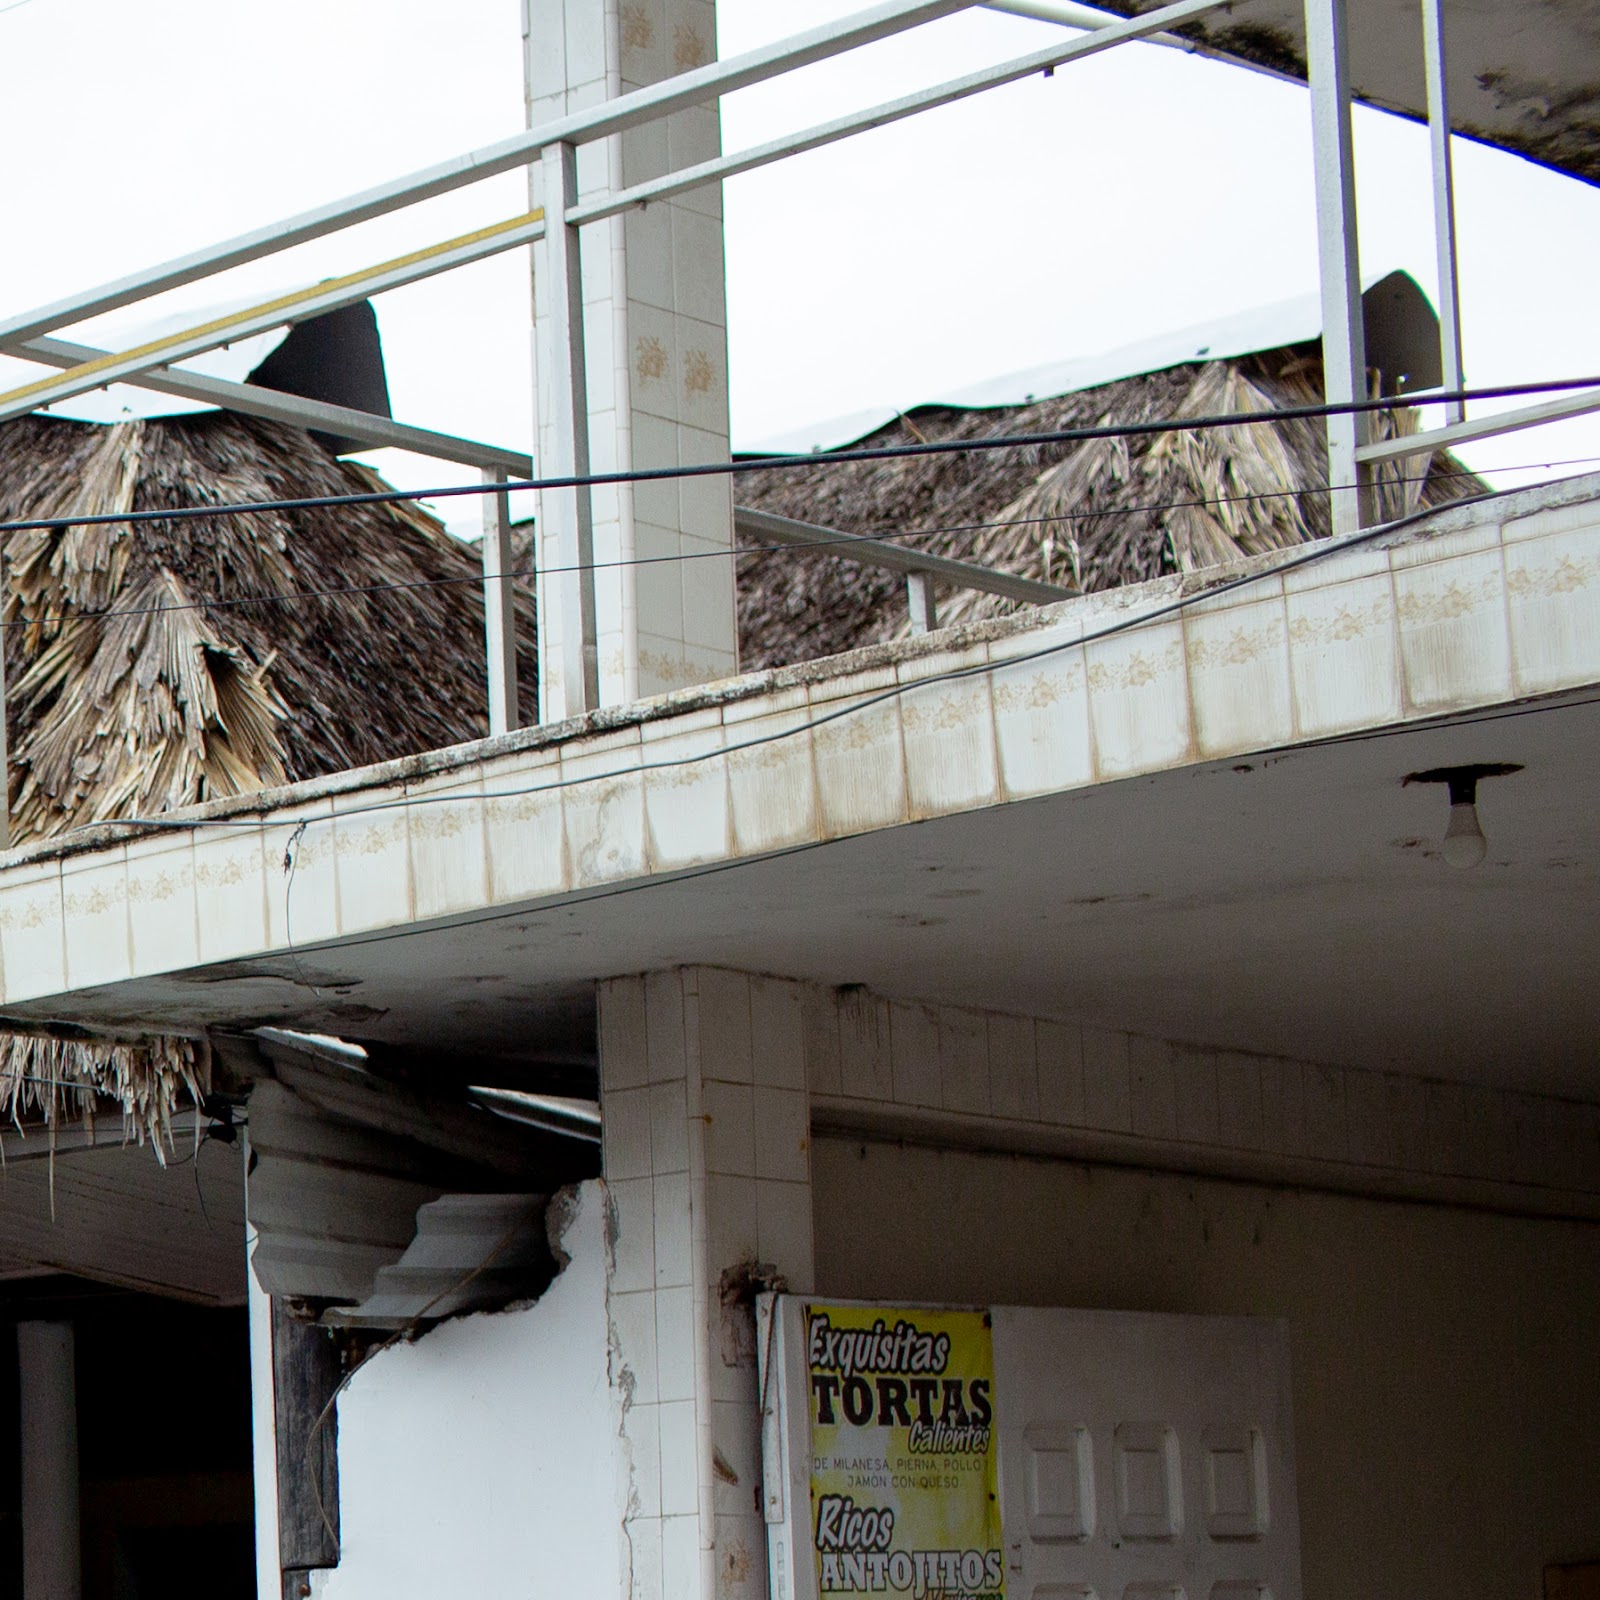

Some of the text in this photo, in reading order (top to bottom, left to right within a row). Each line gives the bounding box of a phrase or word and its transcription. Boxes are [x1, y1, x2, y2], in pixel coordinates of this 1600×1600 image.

[809, 1314, 950, 1381] Exquisitas
[812, 1374, 992, 1427] TORTAS
[908, 1420, 990, 1453] Calientes
[814, 1458, 828, 1471] DE
[833, 1458, 892, 1473] MILANESA,
[896, 1458, 941, 1473] PIERNA,
[944, 1458, 982, 1472] POLLO
[892, 1476, 916, 1488] CON
[921, 1475, 959, 1488] QUESO
[816, 1494, 895, 1550] Ricos
[821, 1550, 1003, 1600] ANTOJITOS
